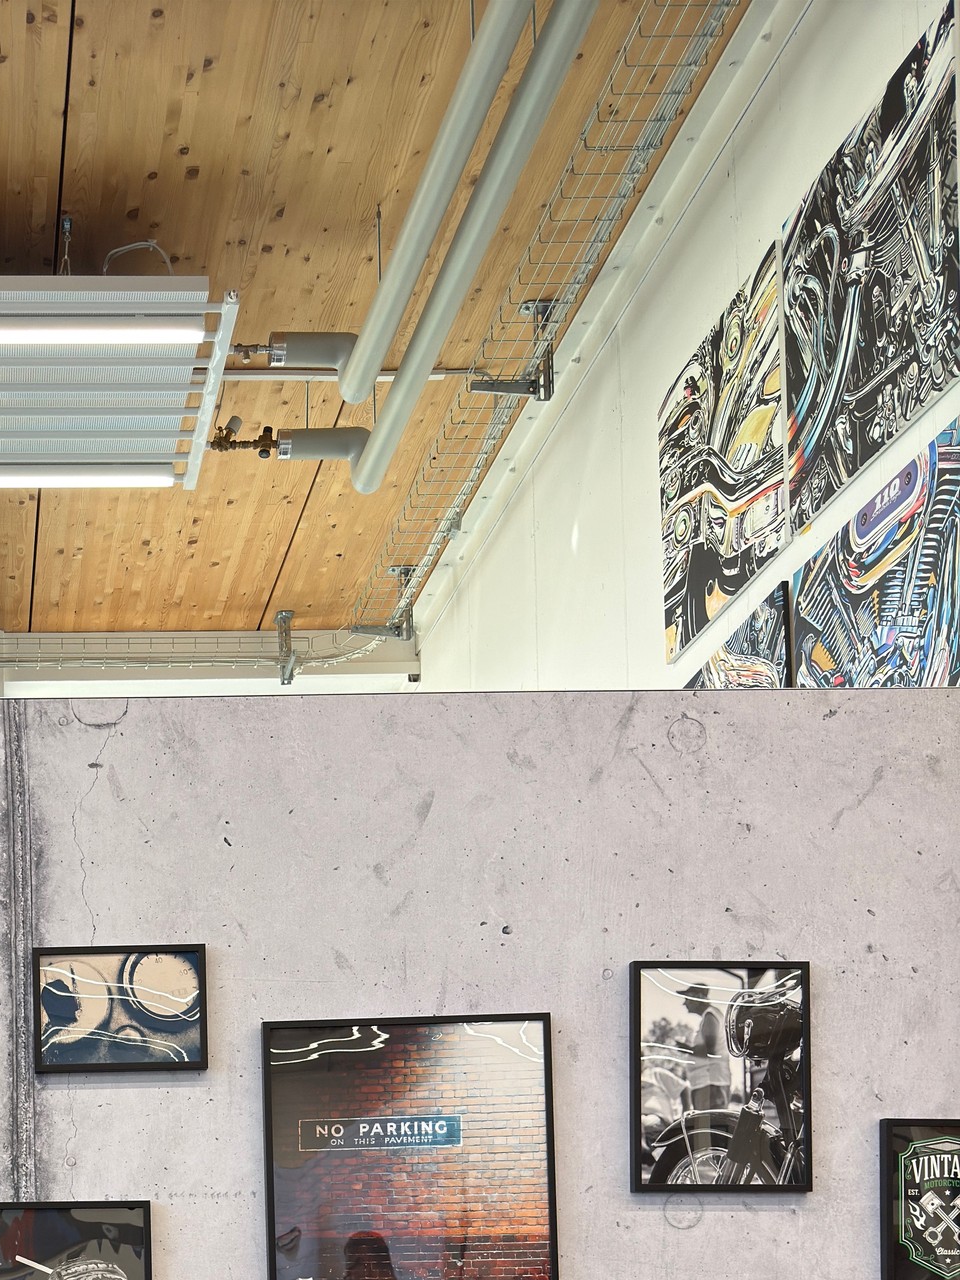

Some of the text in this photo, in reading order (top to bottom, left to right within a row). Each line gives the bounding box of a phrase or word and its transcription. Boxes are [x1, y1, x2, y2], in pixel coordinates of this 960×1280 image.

[315, 1120, 448, 1138] NO PARKING
[330, 1135, 433, 1146] ON THIS PAVEMENT
[911, 1154, 960, 1184] VINTA
